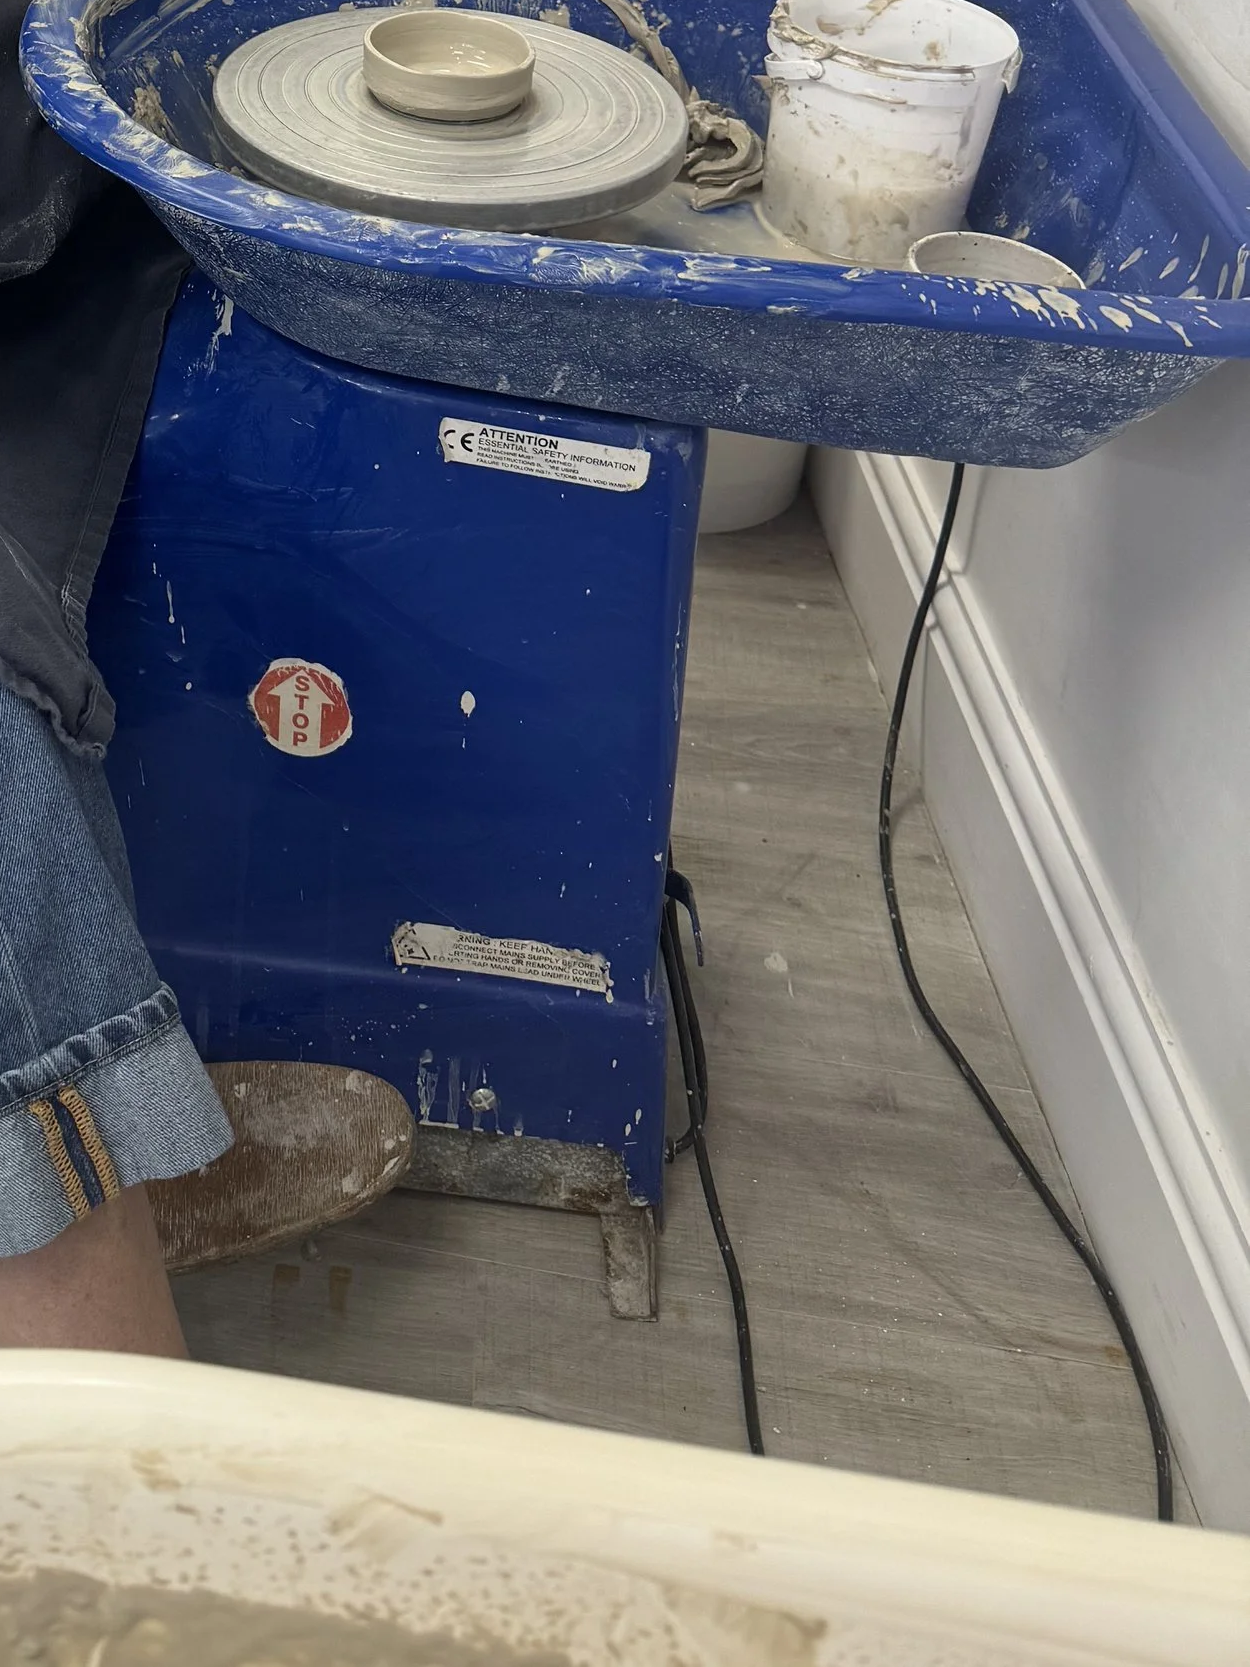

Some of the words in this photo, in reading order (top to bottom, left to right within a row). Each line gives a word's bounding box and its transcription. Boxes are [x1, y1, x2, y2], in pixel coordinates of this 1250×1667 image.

[479, 427, 559, 450] ATTENTION
[478, 437, 528, 453] ESSENTIAL
[532, 447, 568, 460] SAFETY
[570, 454, 636, 472] INFORMATION
[491, 448, 518, 458] MACHINE
[476, 458, 500, 466] FAILURE
[510, 464, 534, 472] FOLLOW
[493, 454, 536, 467] INSTRUCTIONS
[291, 675, 310, 747] STOP
[481, 955, 510, 964] HANDS
[499, 949, 525, 959] MAINS
[527, 954, 560, 964] SUPPLY
[562, 960, 596, 970] BEFORE
[490, 963, 516, 972] MAINS
